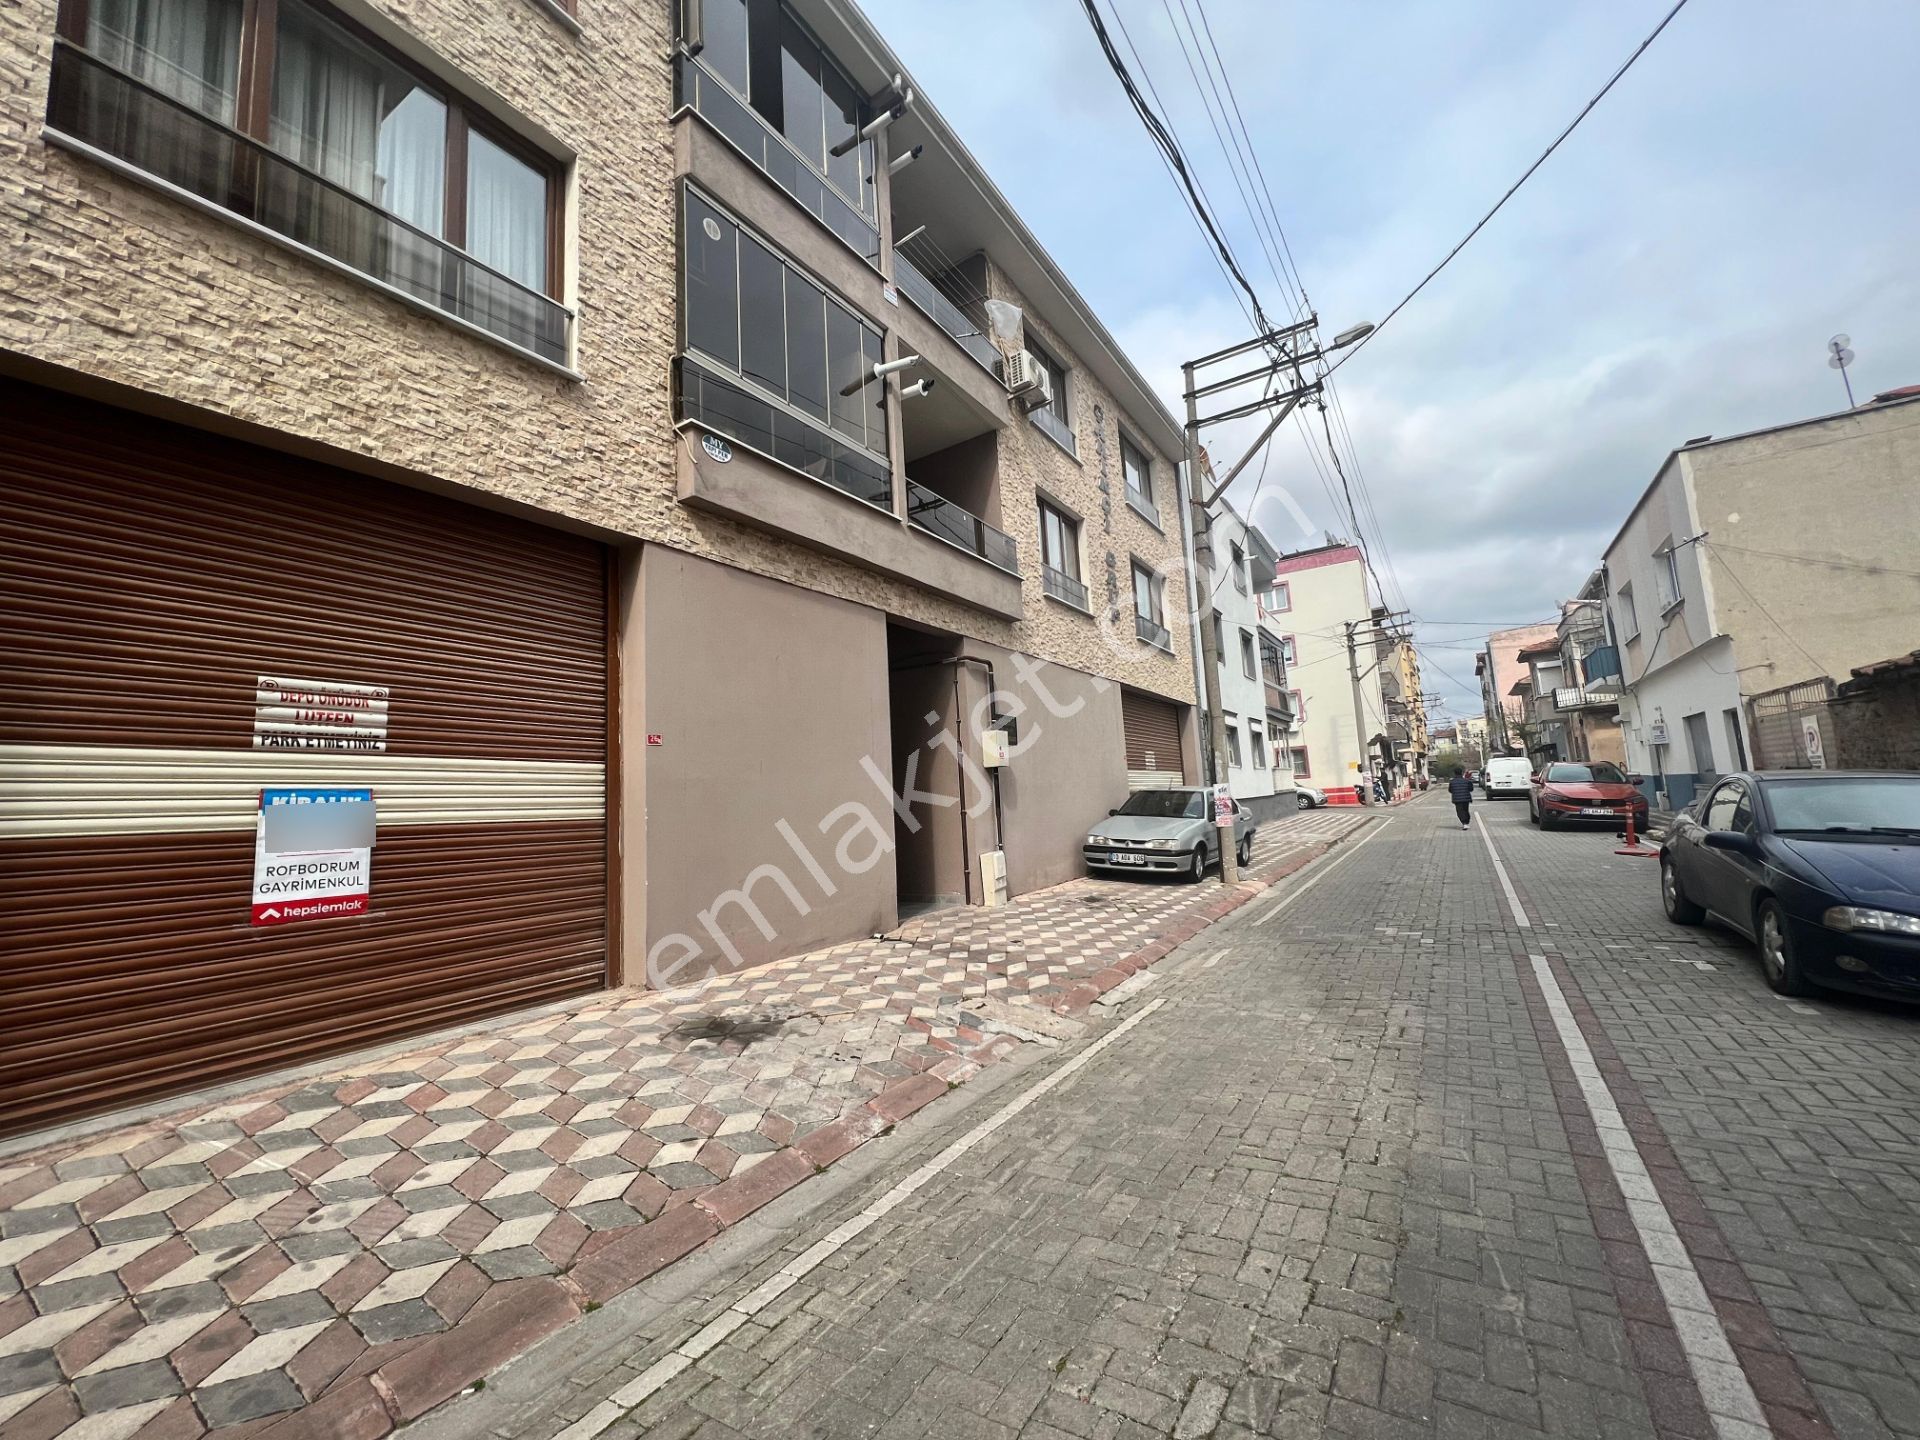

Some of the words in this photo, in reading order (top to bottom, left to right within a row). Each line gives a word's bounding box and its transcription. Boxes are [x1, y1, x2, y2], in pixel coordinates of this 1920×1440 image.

[710, 436, 723, 449] MY
[266, 861, 360, 877] ROFBODRUM
[259, 876, 364, 894] GAYRİMENKUL
[283, 900, 363, 917] hepsiemlak
